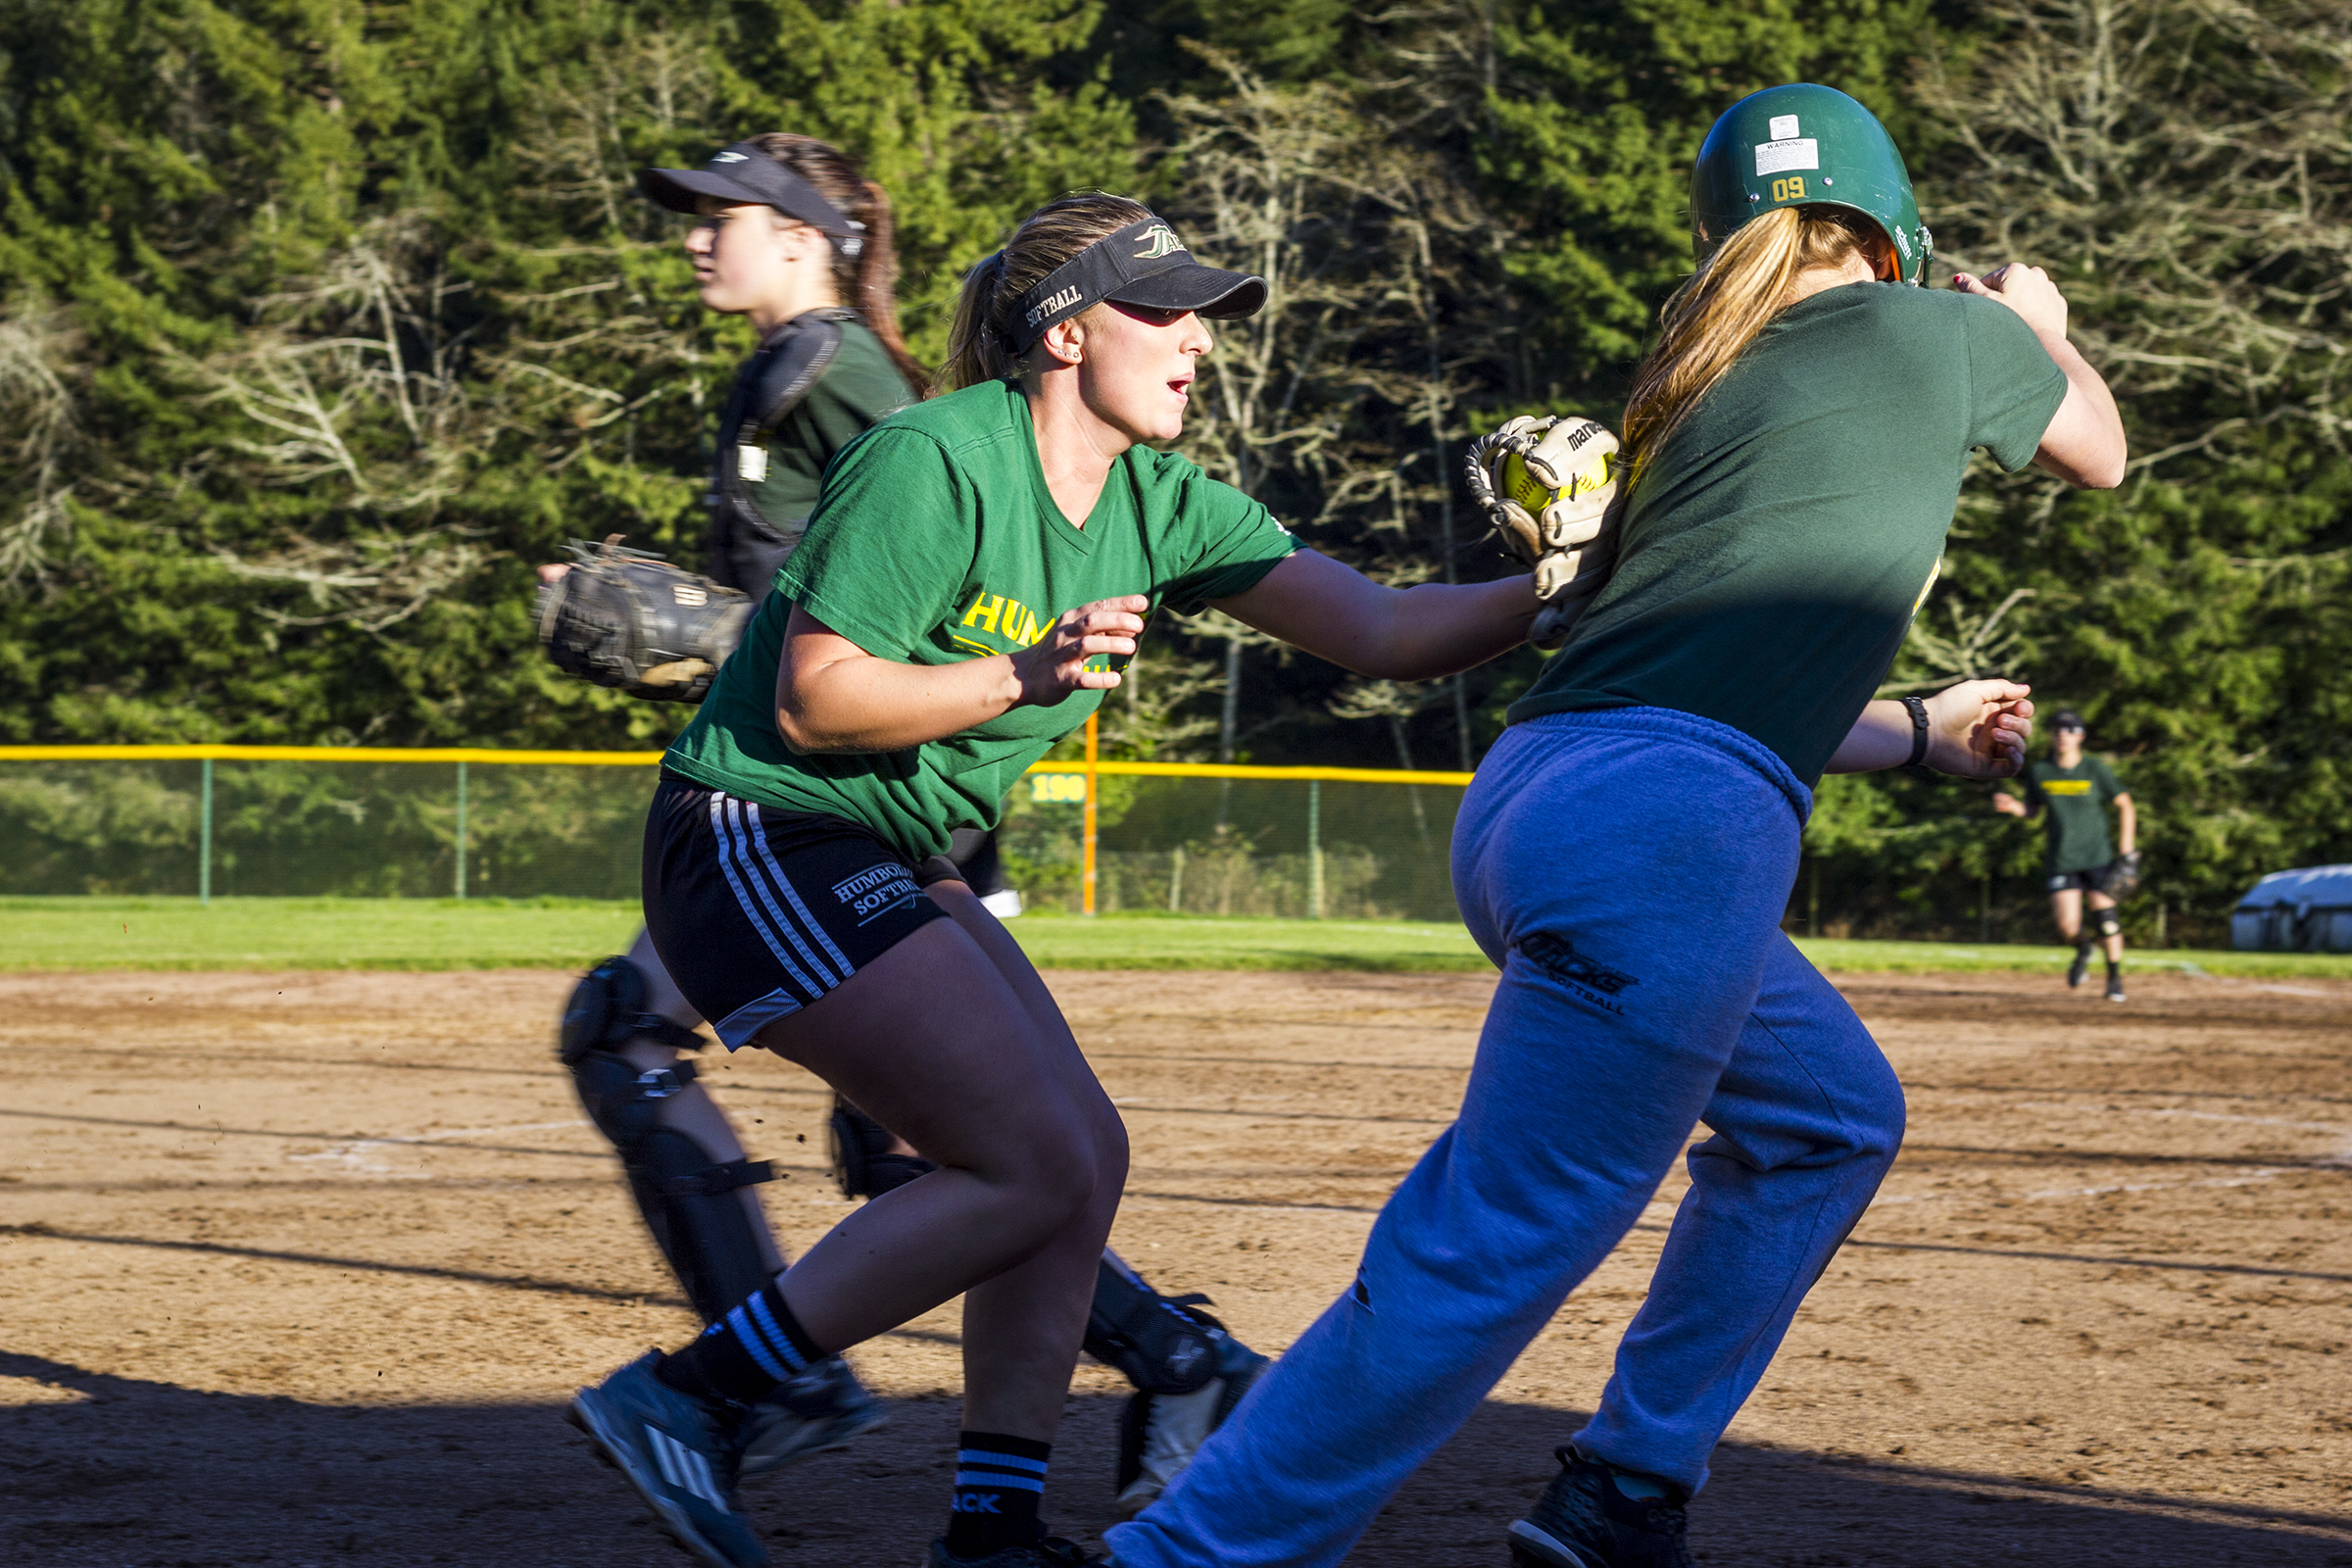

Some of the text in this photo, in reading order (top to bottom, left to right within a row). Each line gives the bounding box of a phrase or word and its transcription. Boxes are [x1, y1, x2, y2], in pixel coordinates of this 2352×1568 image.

[1767, 140, 1804, 149] WARNING
[1772, 176, 1806, 203] 09
[1025, 284, 1083, 328] SOFTBALL
[961, 591, 1055, 648] HUM
[1032, 774, 1086, 802] 190
[834, 864, 913, 904] HUMBOLD
[1547, 971, 1625, 1016] SOFTBALL
